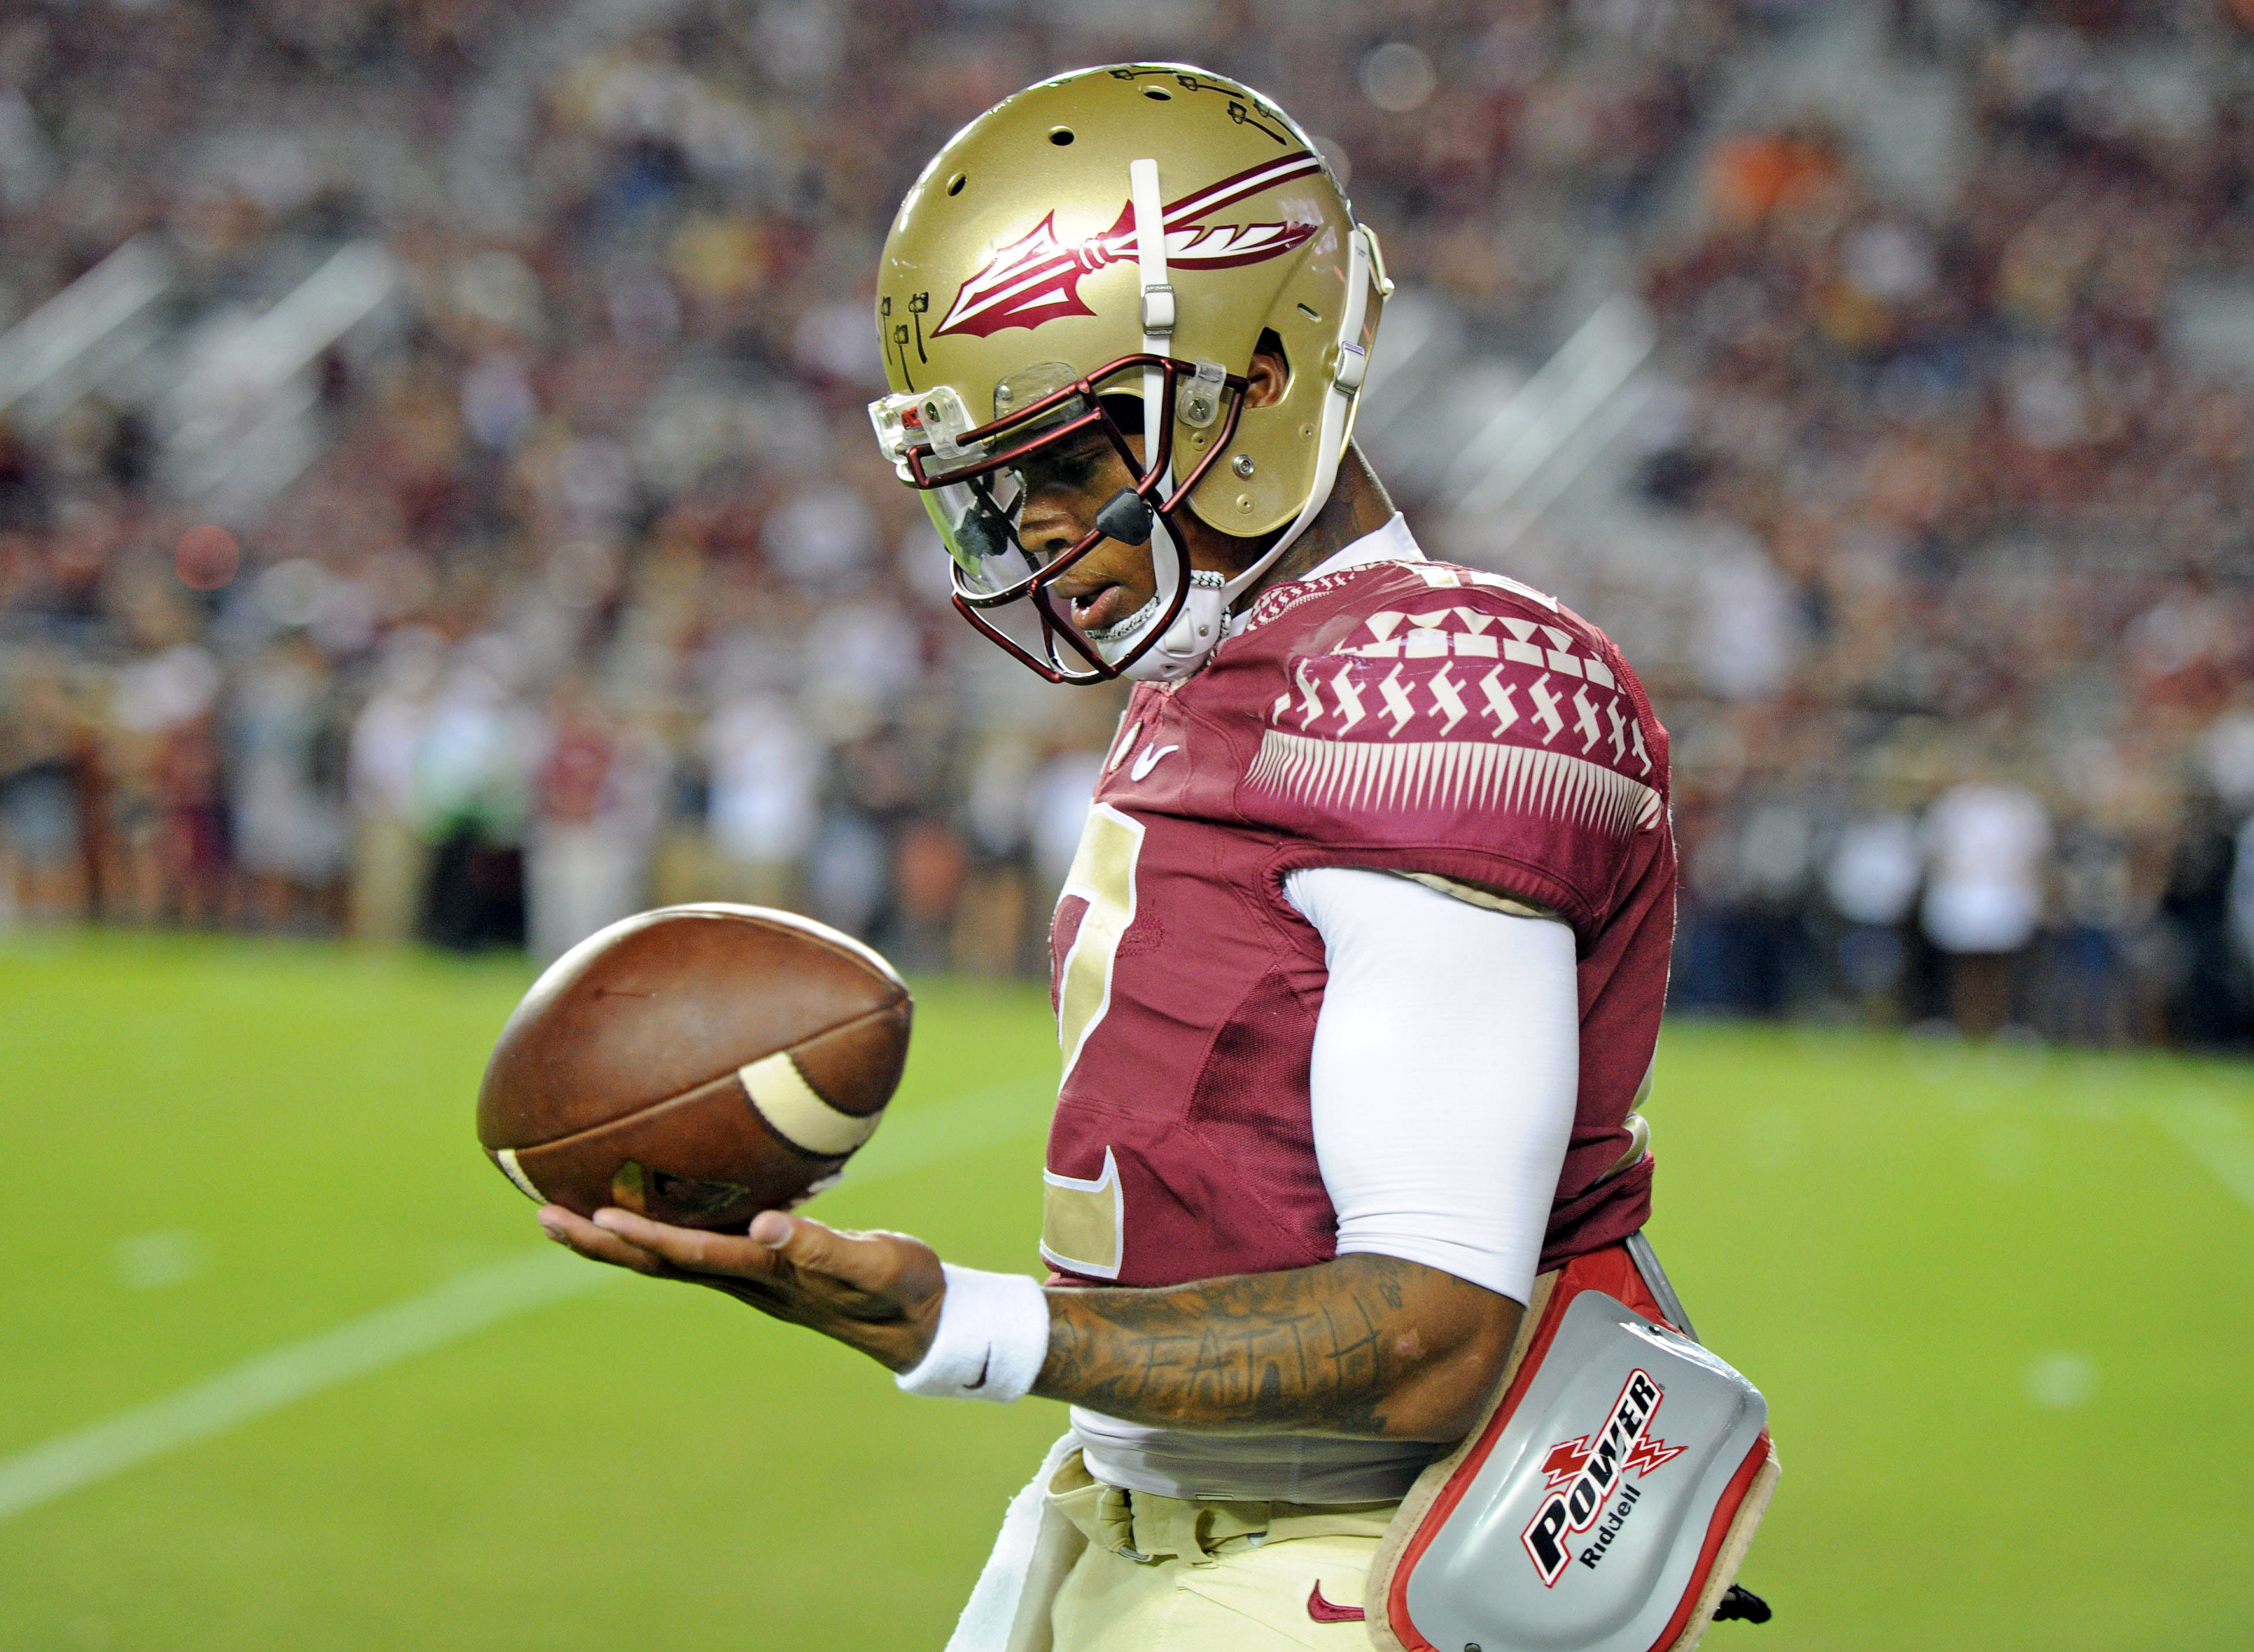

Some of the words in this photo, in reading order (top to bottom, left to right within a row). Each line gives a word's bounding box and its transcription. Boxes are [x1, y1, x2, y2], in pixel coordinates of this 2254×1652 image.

[1129, 1293, 1382, 1401] FAITH
[1525, 1371, 1660, 1582] POWER
[1579, 1483, 1641, 1569] Riddell
